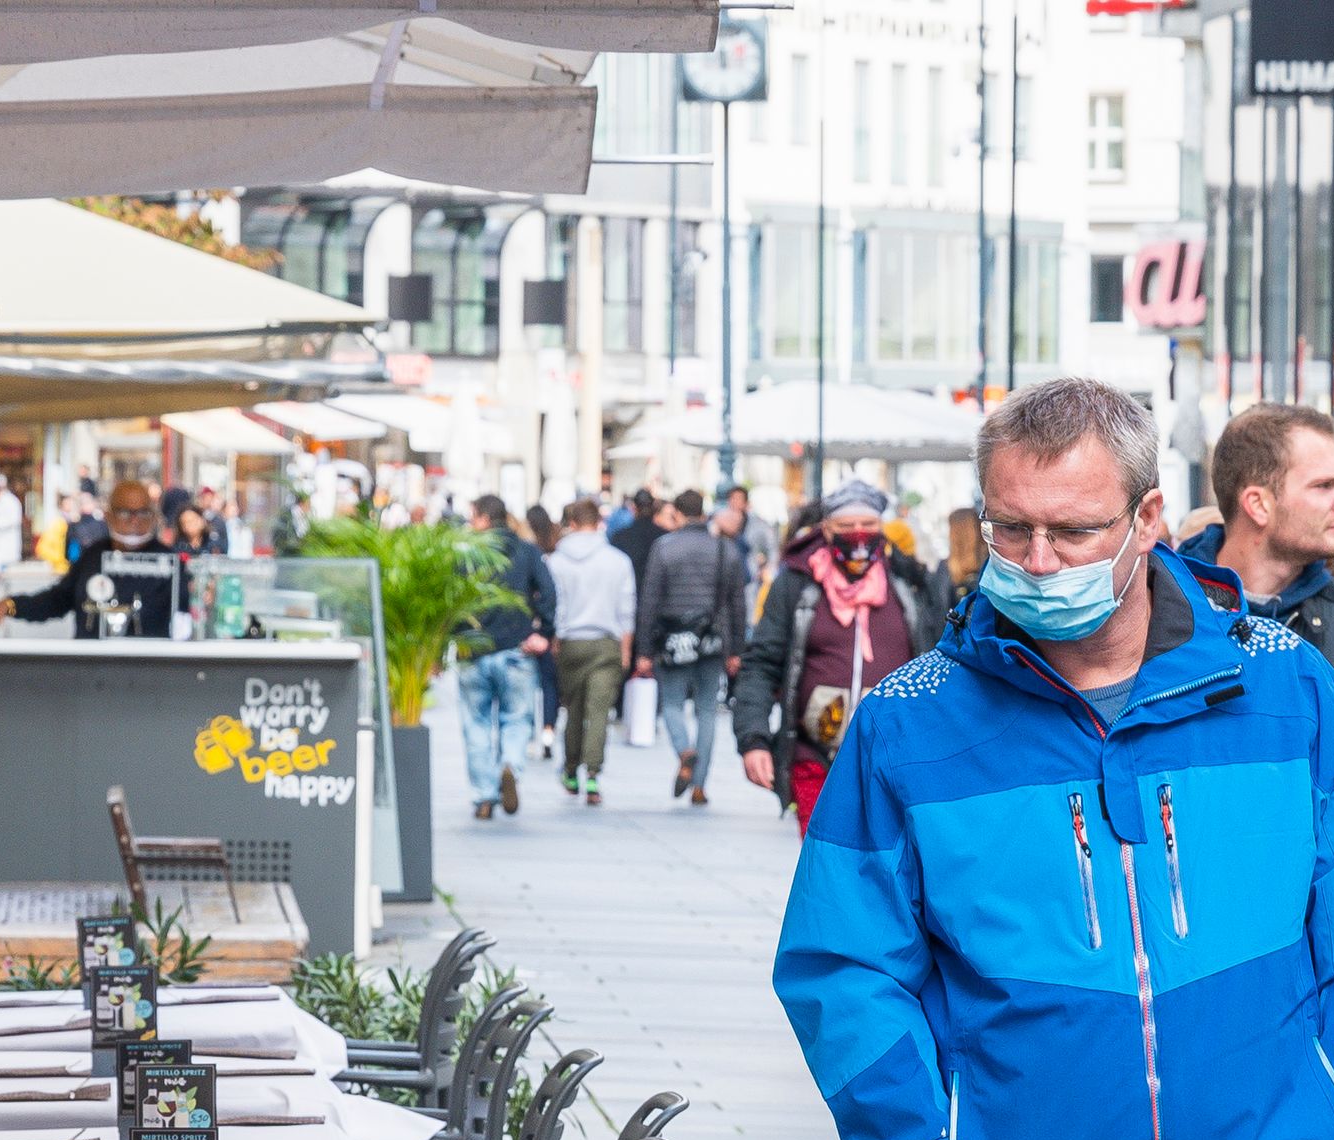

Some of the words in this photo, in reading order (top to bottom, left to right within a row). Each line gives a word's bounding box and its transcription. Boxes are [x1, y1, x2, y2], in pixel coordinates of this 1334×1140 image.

[244, 677, 324, 707] Don't
[240, 704, 330, 735] worry
[238, 739, 337, 783] beer
[264, 770, 355, 807] happy
